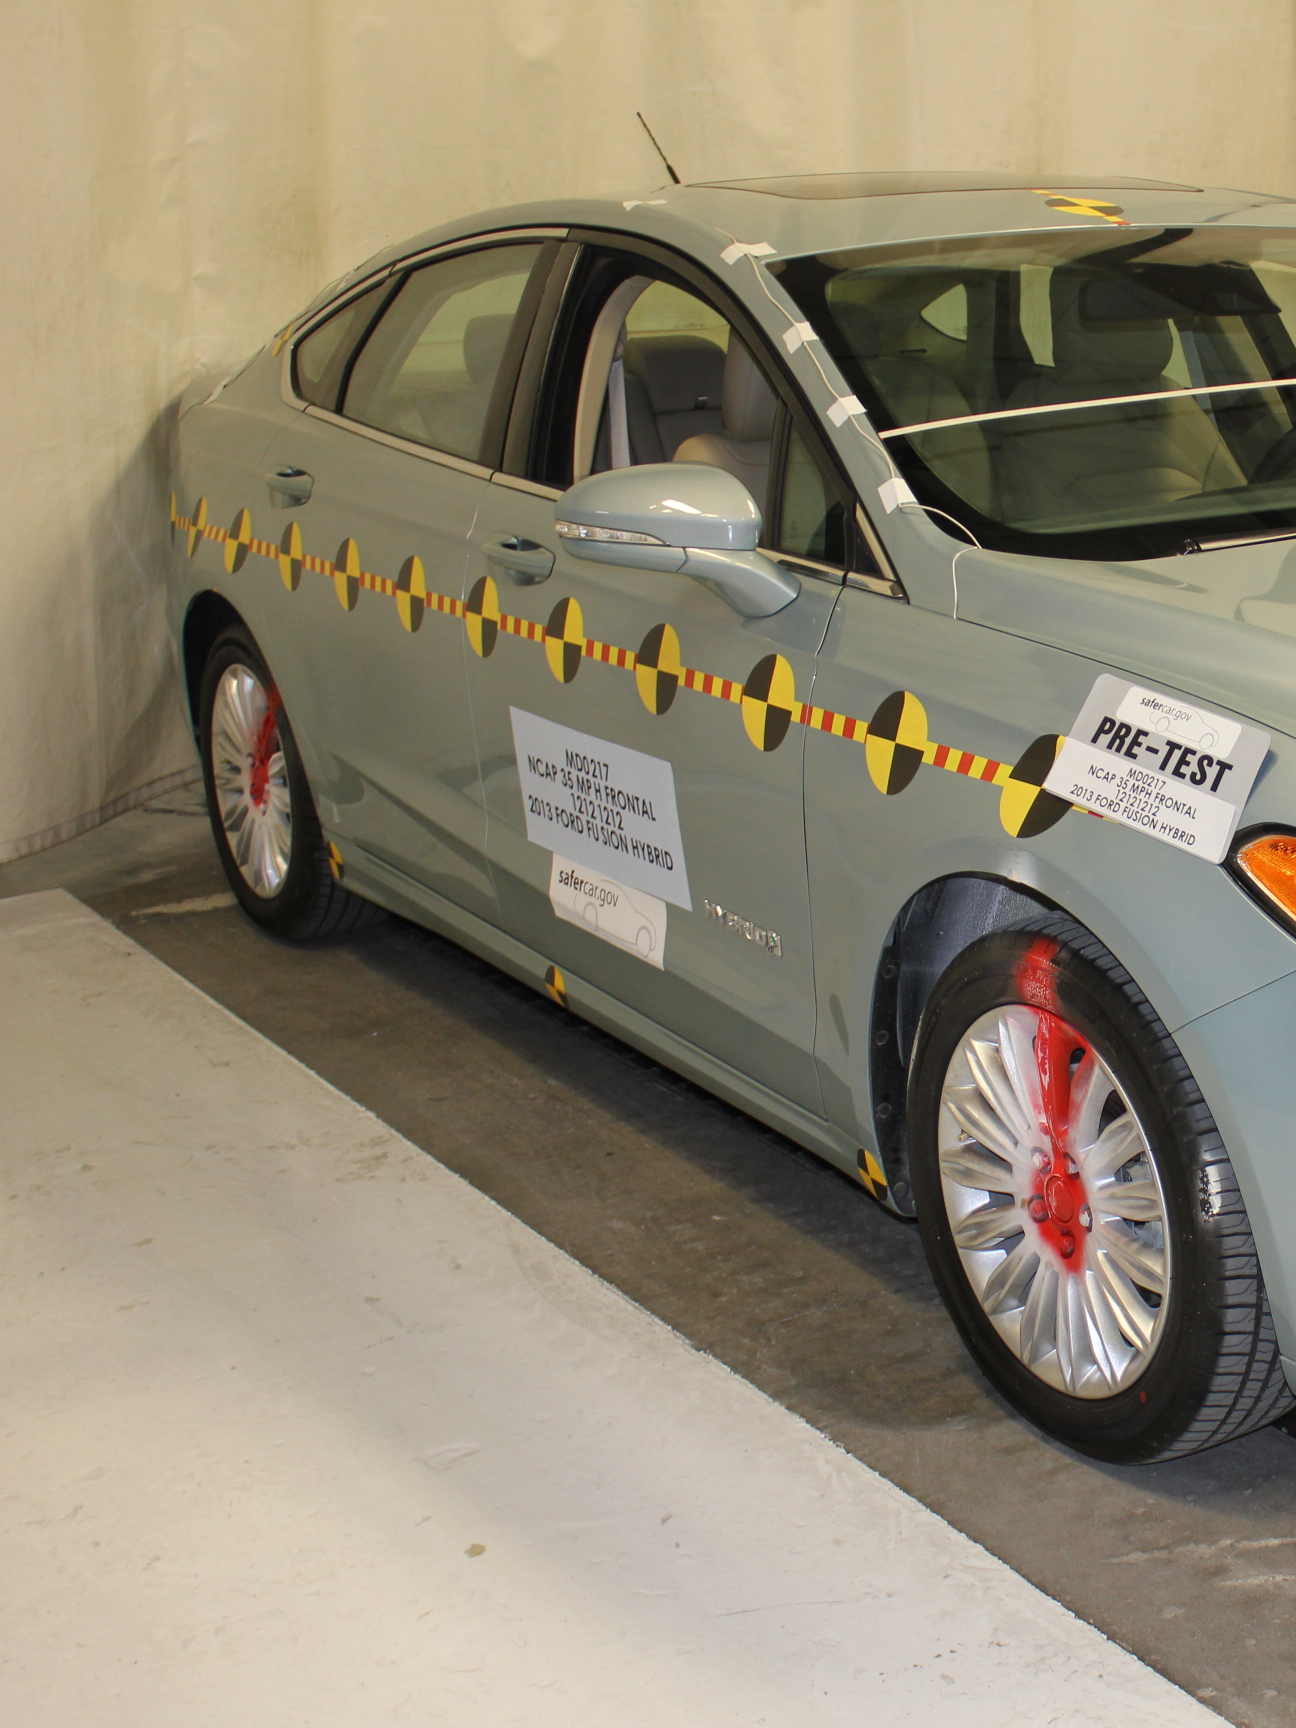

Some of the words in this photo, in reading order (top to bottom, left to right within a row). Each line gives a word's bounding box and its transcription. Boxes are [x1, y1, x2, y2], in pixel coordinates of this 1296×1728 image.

[1139, 696, 1193, 722] safercar.gov
[565, 748, 609, 782] MD0217
[1090, 715, 1234, 793] PRE-TEST
[527, 754, 558, 782] NCAP
[560, 767, 574, 790] 35
[576, 775, 603, 801] MPH
[604, 785, 656, 822] FRONTAL
[1087, 764, 1117, 784] NCAP
[1116, 776, 1129, 790] 35
[1128, 782, 1153, 800] MPH
[1153, 792, 1198, 820] FRONTAL
[1126, 767, 1167, 791] MD0217
[571, 792, 624, 831] 12121212
[1069, 783, 1095, 802] 2013
[1094, 794, 1121, 813] FORD
[1121, 806, 1159, 830] FUSION
[1159, 821, 1196, 846] HYBRID
[1114, 789, 1160, 817] 12121212
[528, 794, 553, 821] 2013
[555, 805, 584, 834] FORD
[586, 819, 629, 855] FUSION
[631, 837, 674, 871] HYBRID
[558, 869, 620, 908] safercar.gov
